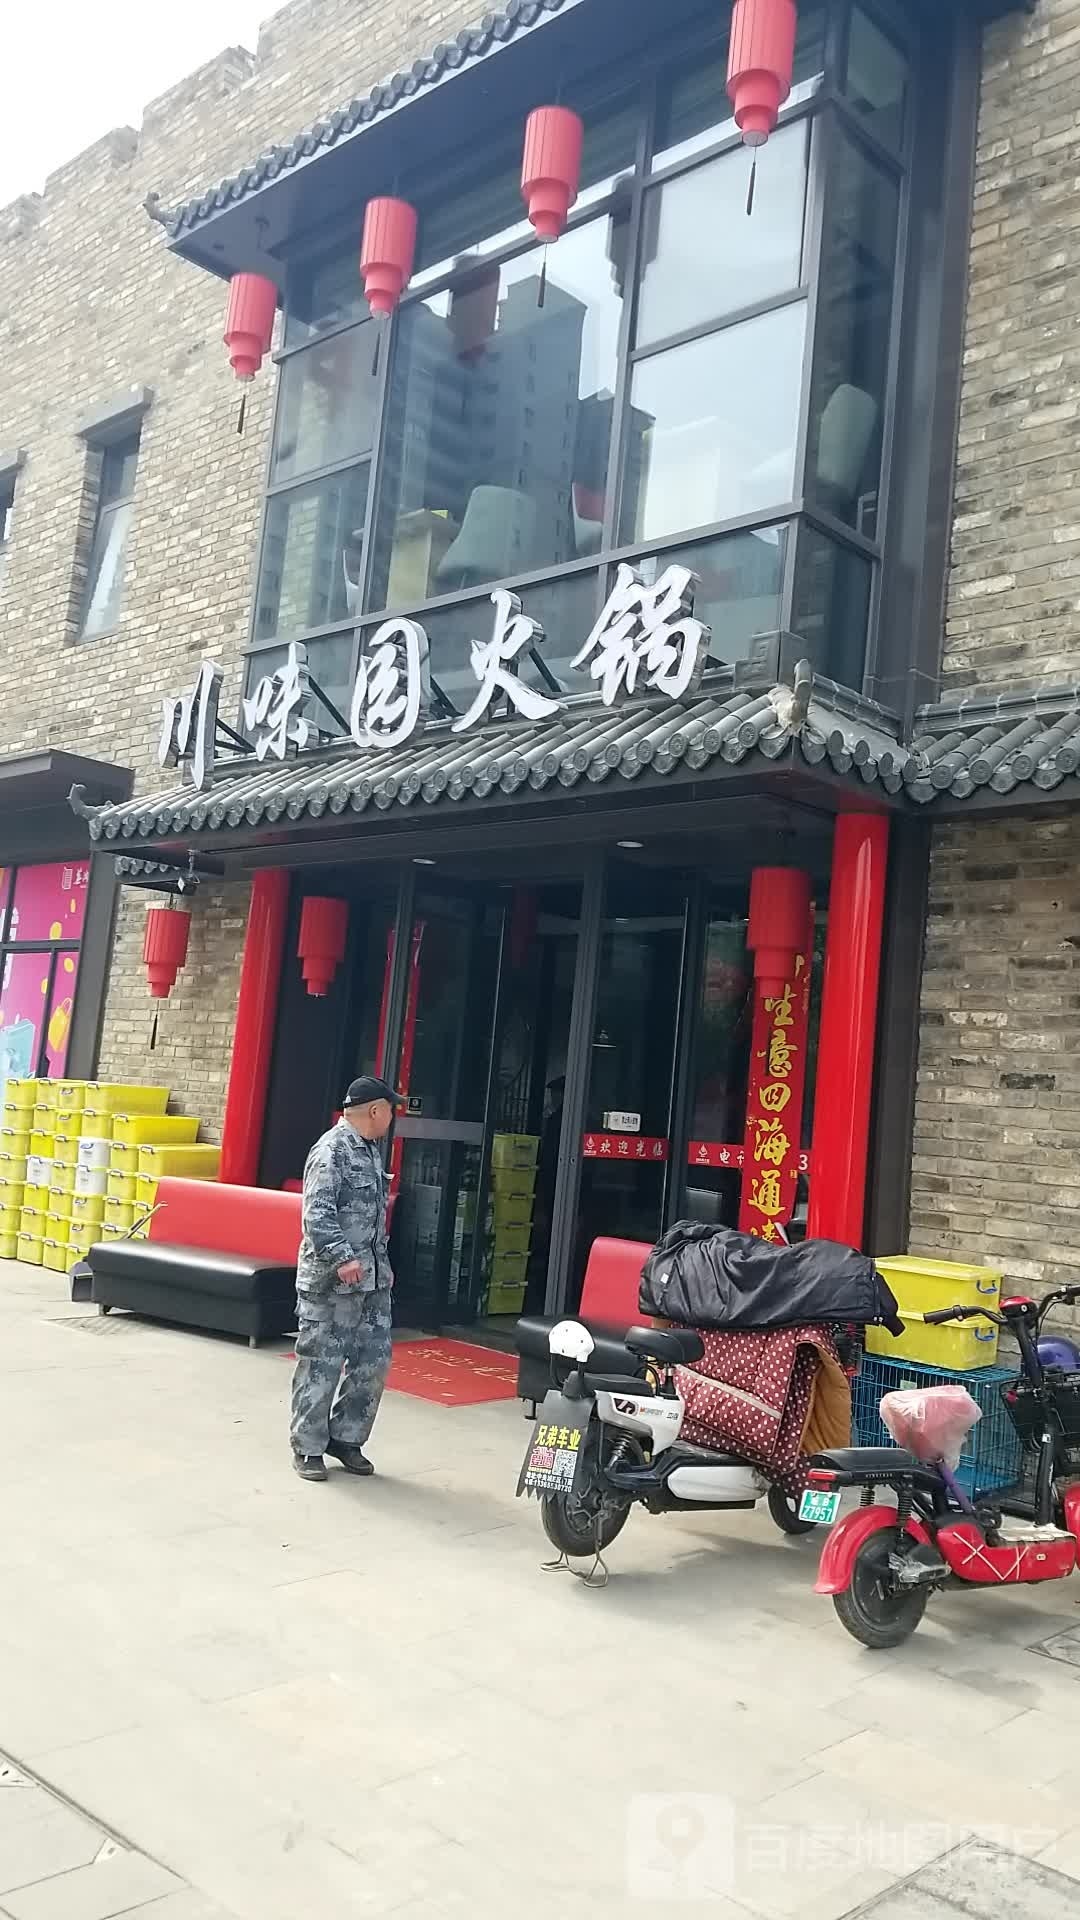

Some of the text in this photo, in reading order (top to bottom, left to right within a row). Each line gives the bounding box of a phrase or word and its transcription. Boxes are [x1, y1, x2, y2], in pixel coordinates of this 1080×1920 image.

[600, 1139, 663, 1157] 欢迎光临
[536, 1425, 580, 1450] 兄弟车业
